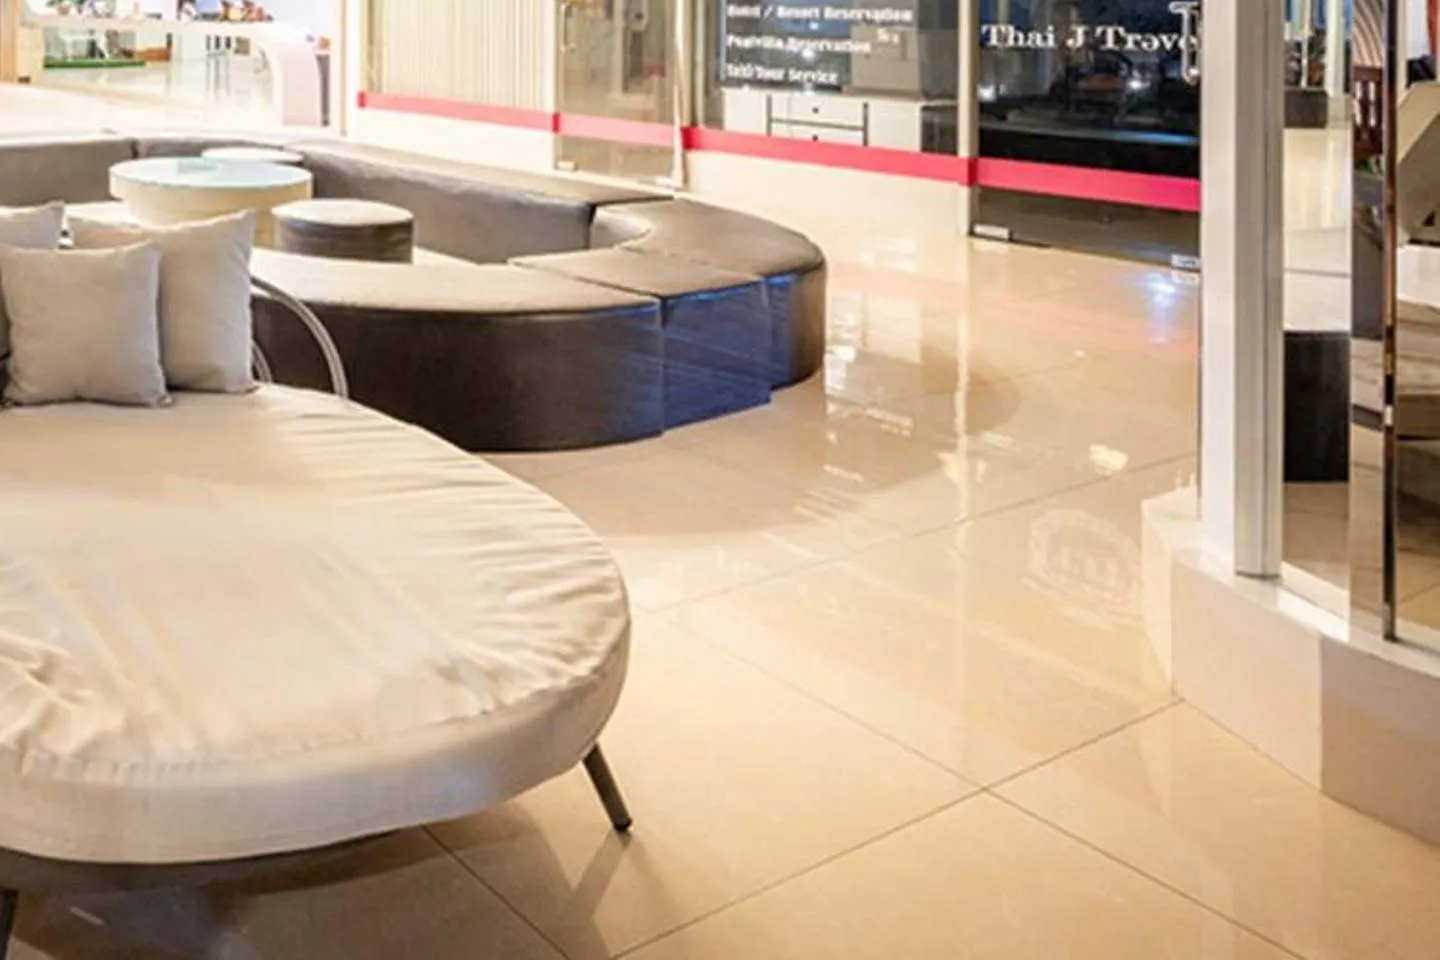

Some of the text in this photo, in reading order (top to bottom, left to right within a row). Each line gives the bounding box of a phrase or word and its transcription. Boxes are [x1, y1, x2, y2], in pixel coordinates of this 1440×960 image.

[823, 6, 913, 23] Reservation
[981, 24, 1057, 49] Thai
[1067, 25, 1089, 49] J
